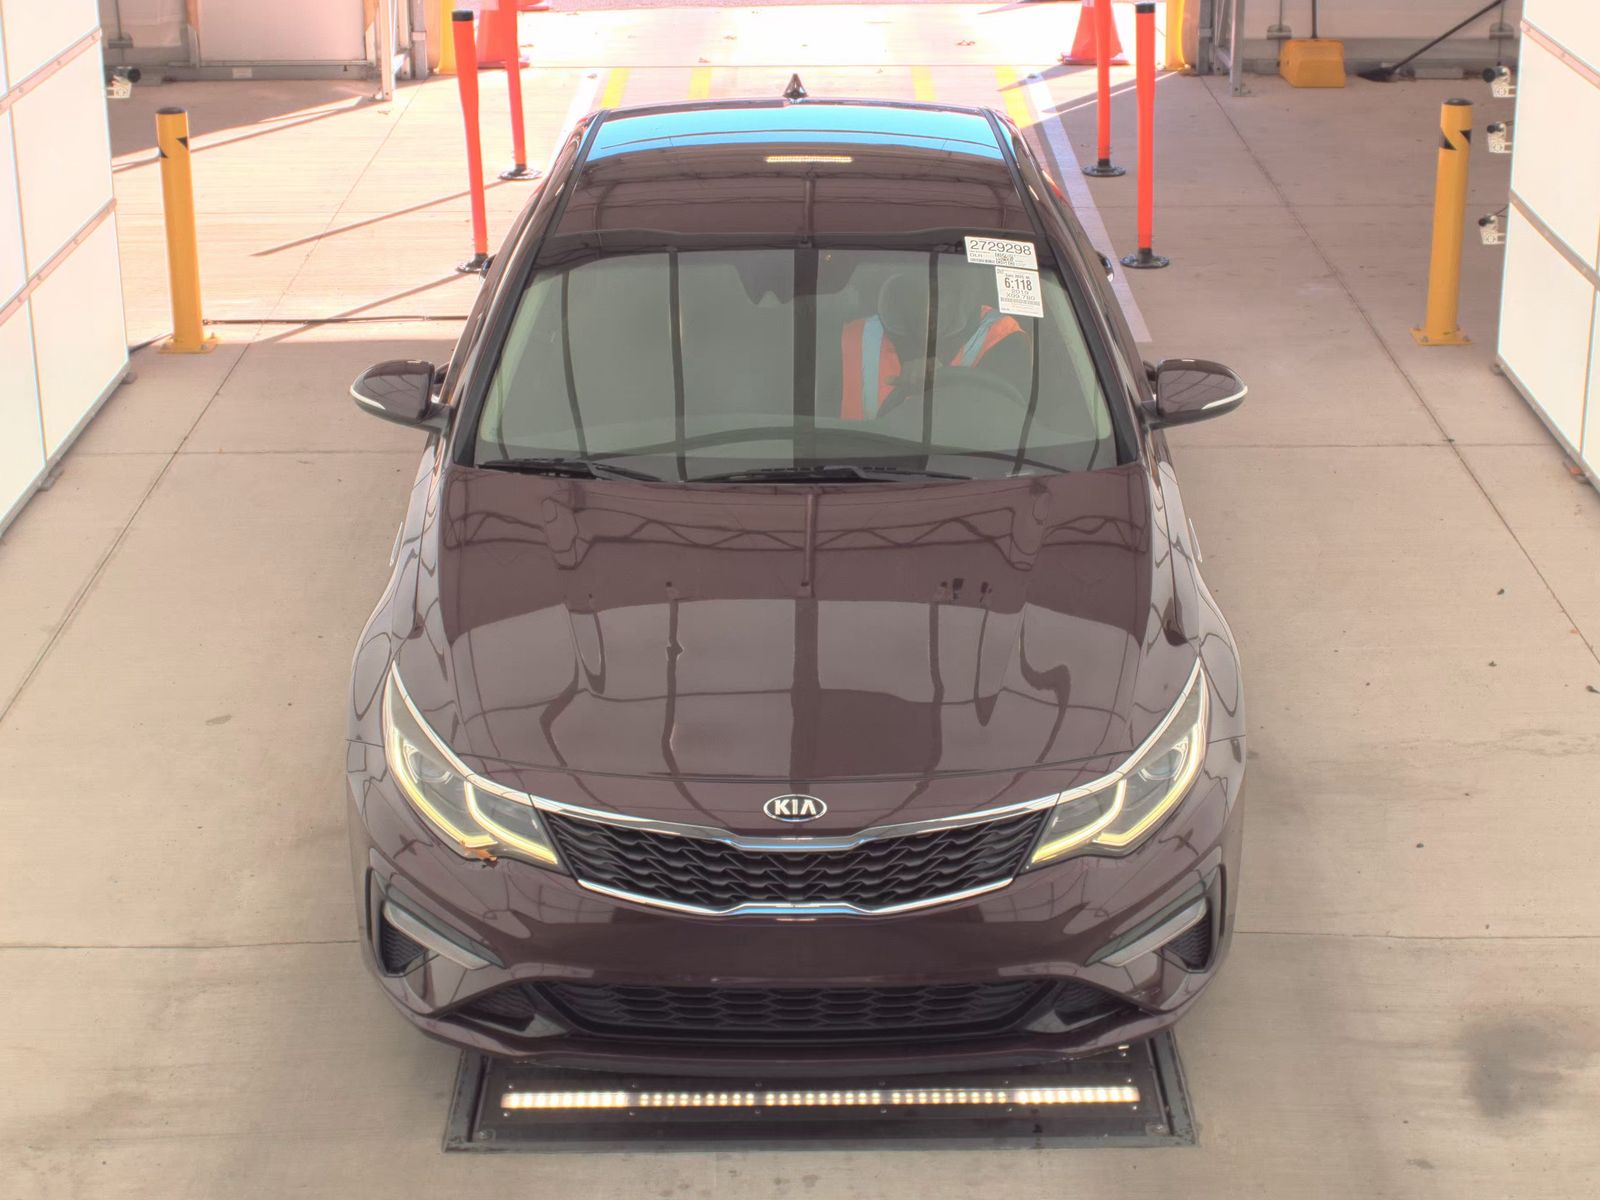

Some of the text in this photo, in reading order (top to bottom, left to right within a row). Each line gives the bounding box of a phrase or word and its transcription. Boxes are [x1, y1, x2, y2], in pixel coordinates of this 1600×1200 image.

[969, 239, 1032, 256] 2729298
[1004, 276, 1033, 291] 6:118
[774, 799, 817, 815] KIA
